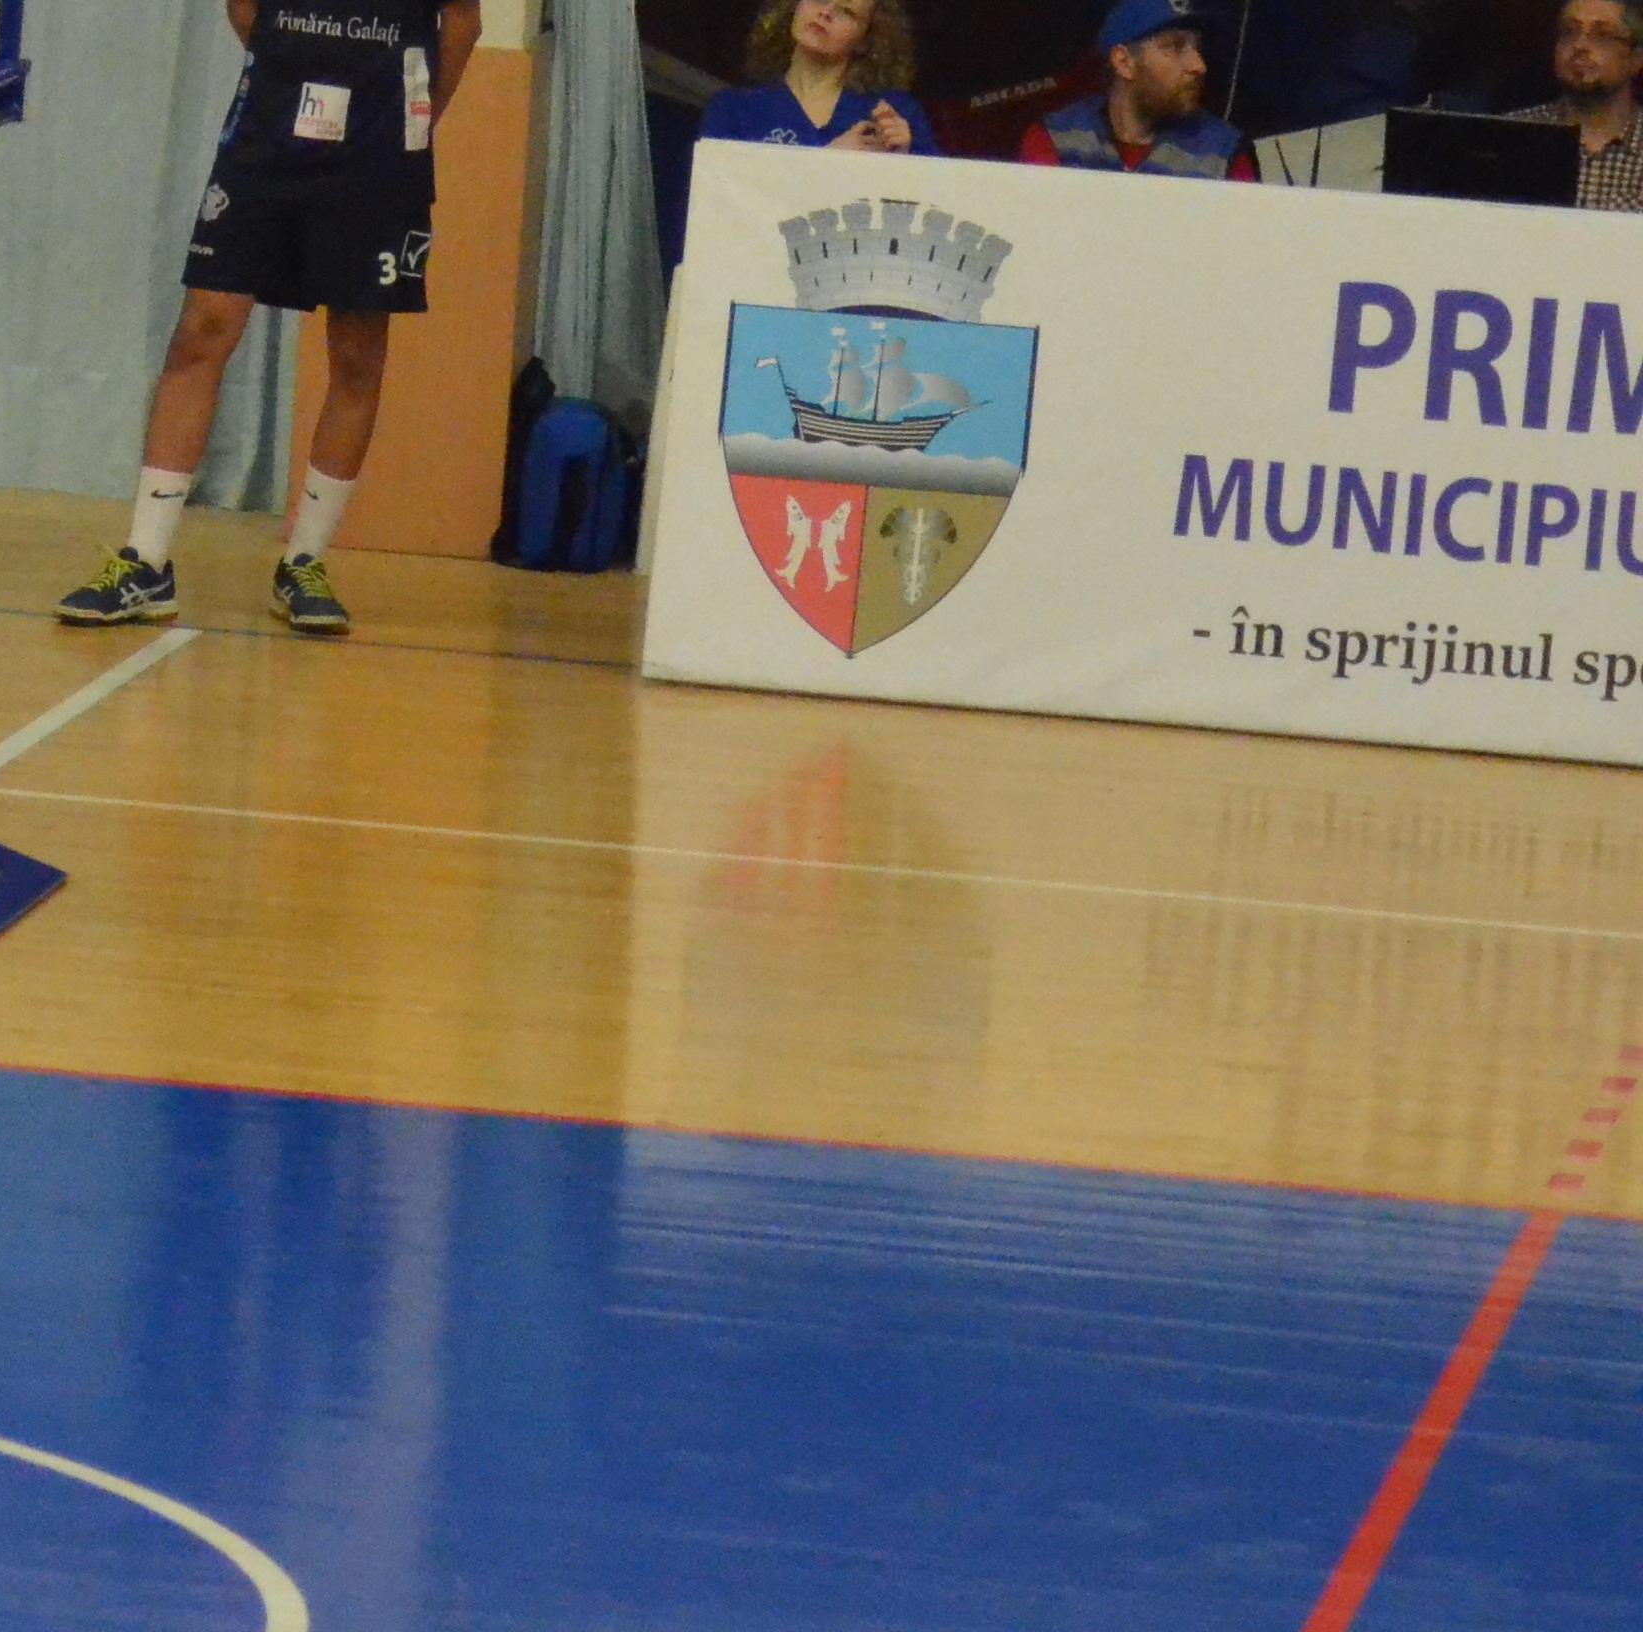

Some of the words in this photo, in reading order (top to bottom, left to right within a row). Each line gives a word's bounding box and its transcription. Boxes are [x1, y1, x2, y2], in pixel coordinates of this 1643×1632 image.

[378, 252, 398, 286] 3
[1229, 605, 1285, 659] în
[1305, 621, 1554, 685] sprijinul
[1573, 650, 1643, 702] sp
